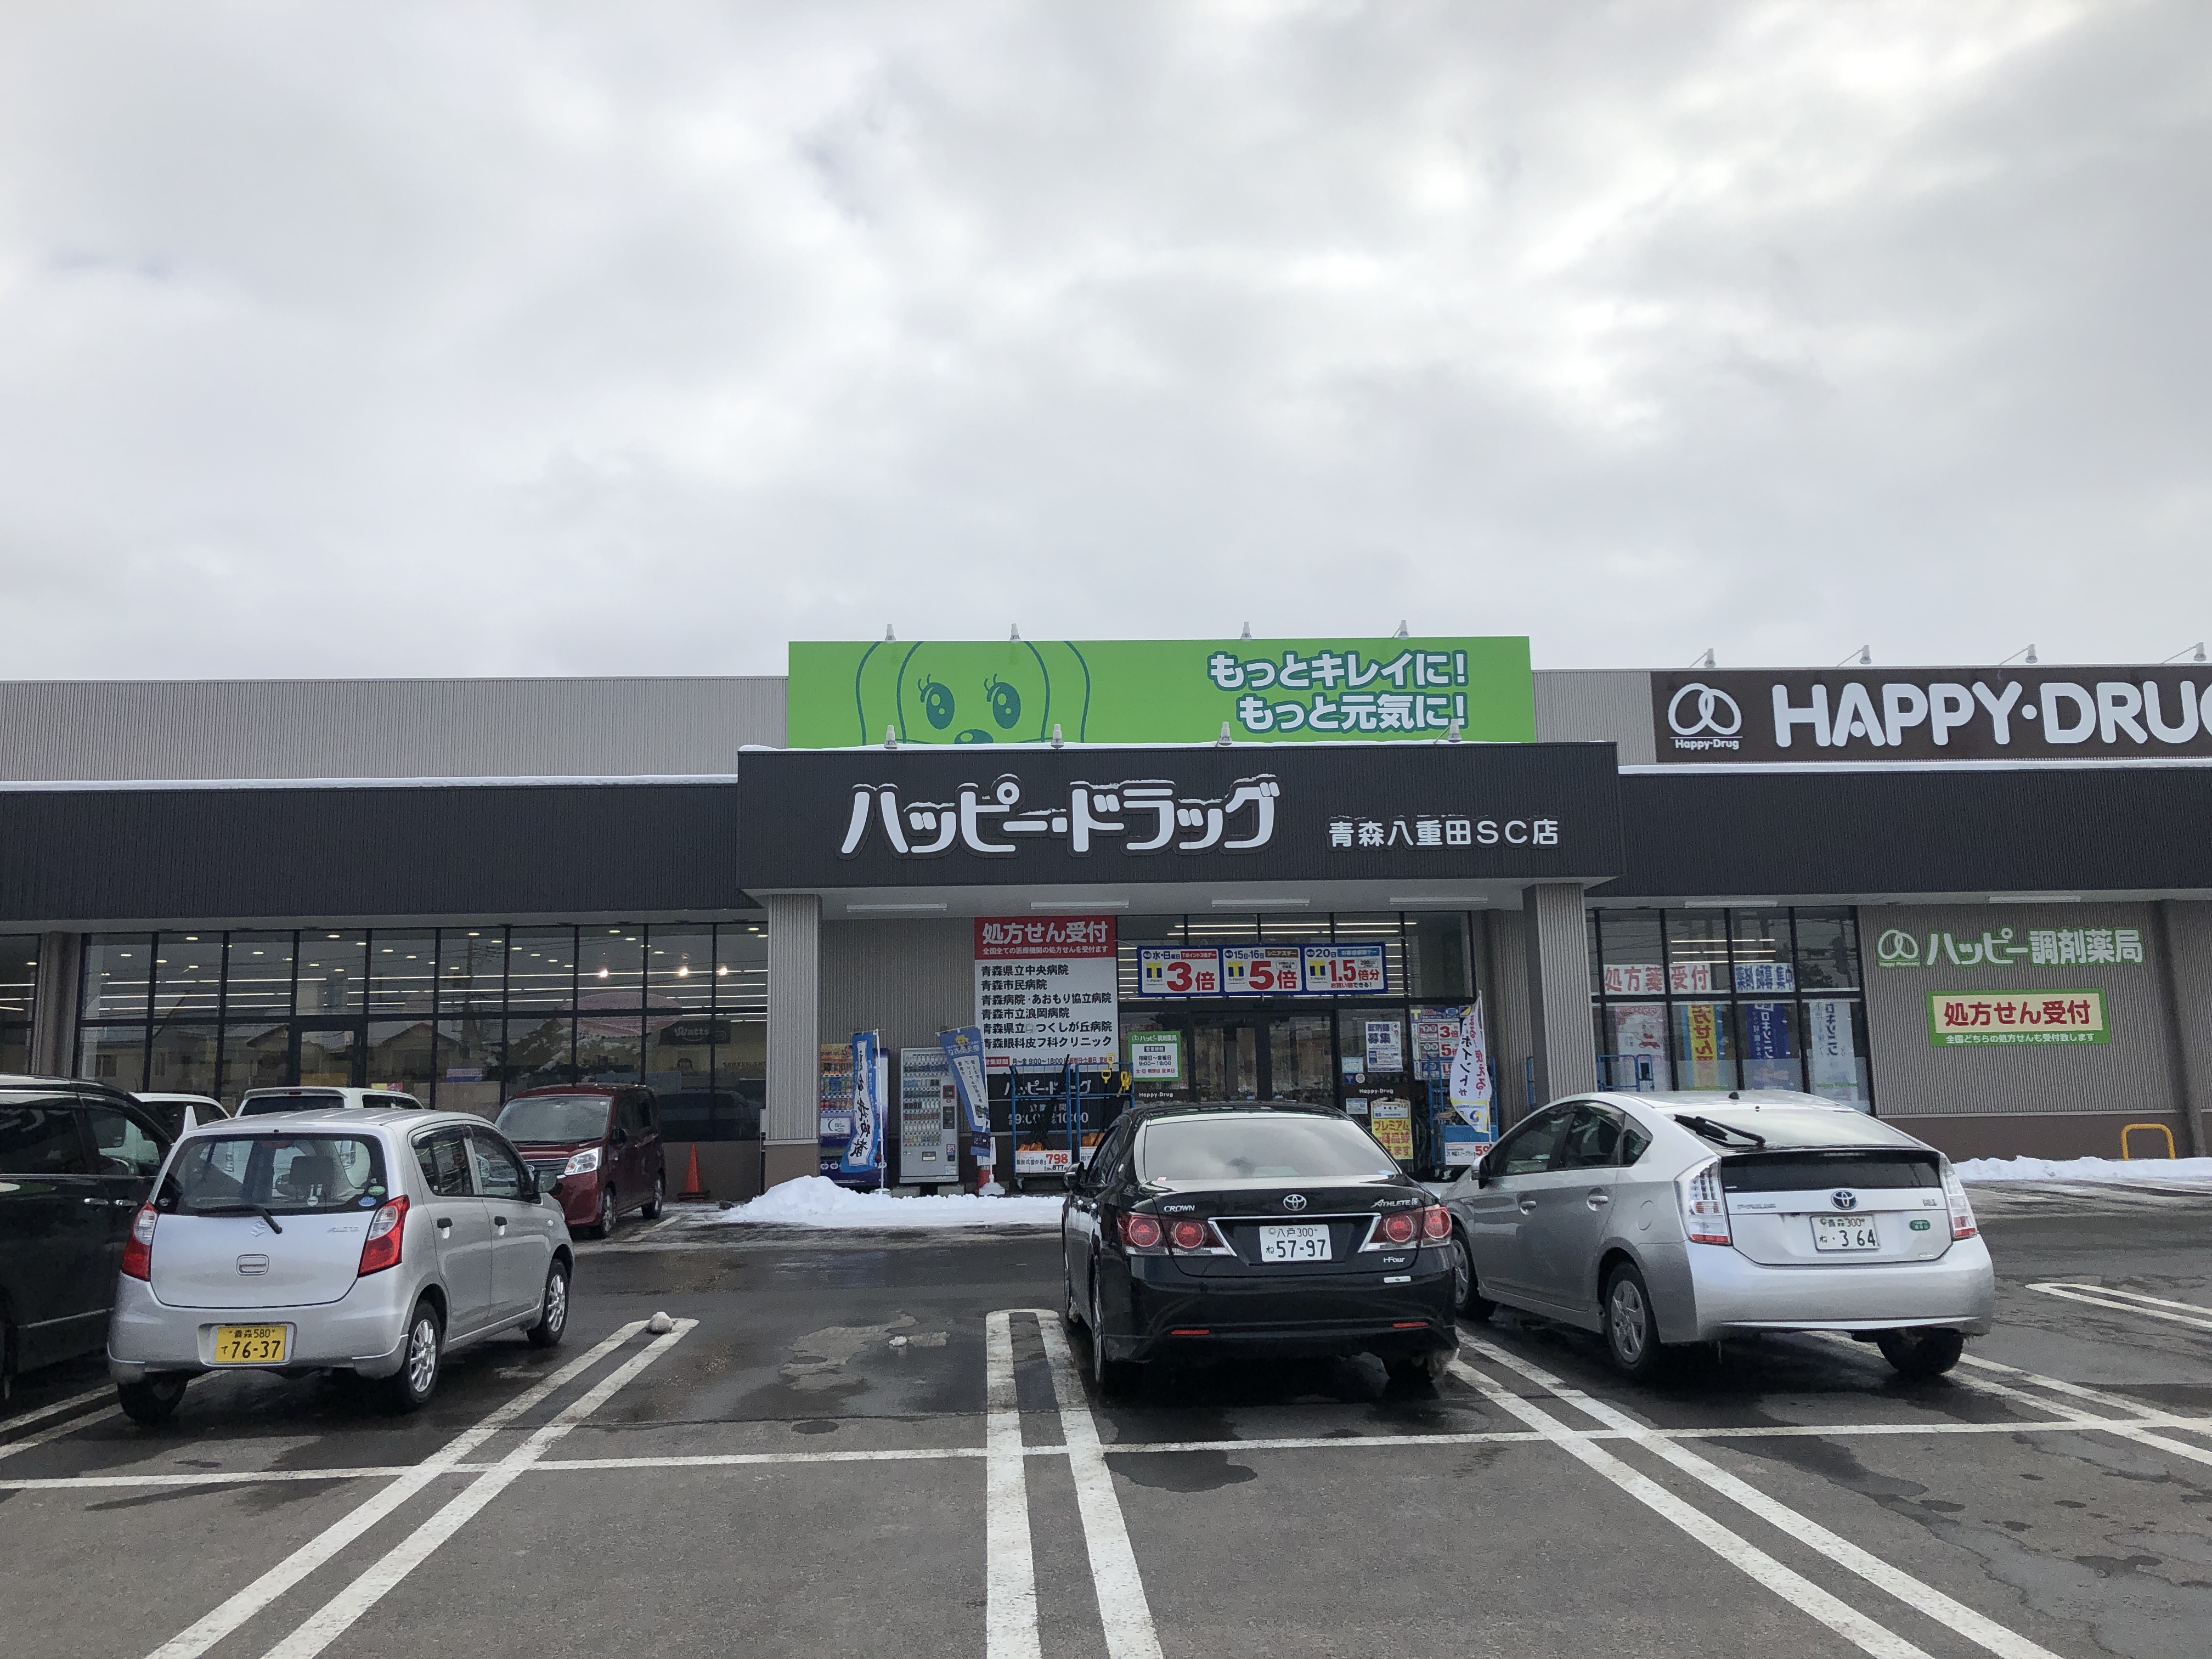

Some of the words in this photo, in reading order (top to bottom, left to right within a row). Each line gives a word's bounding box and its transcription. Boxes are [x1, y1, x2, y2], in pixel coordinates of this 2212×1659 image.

[1209, 652, 1466, 688] もっとキレイに!
[1239, 694, 1467, 731] もっと元気に!
[1329, 820, 1559, 848] 青森八重田SC店
[982, 921, 1108, 944] 処方せん受付
[1315, 949, 1337, 958] 20日
[1927, 928, 2143, 964] ハッピー調剤薬局
[981, 964, 1069, 977] 青森県立中央病院
[981, 979, 1048, 991] 青森市民病院
[981, 1007, 1070, 1020] 青森市立浪岡病院
[1944, 1000, 2091, 1026] 処方せん受付
[983, 1023, 1026, 1035] 青森県立
[1036, 1020, 1113, 1034] つくしが丘病院
[1945, 1032, 2095, 1044] 全国どちらの処方せんも受付致します
[1374, 1120, 1410, 1131] プレミアム
[1046, 1153, 1068, 1165] 798
[1276, 1239, 1326, 1258] 57-97
[232, 1340, 281, 1359] 76-37
